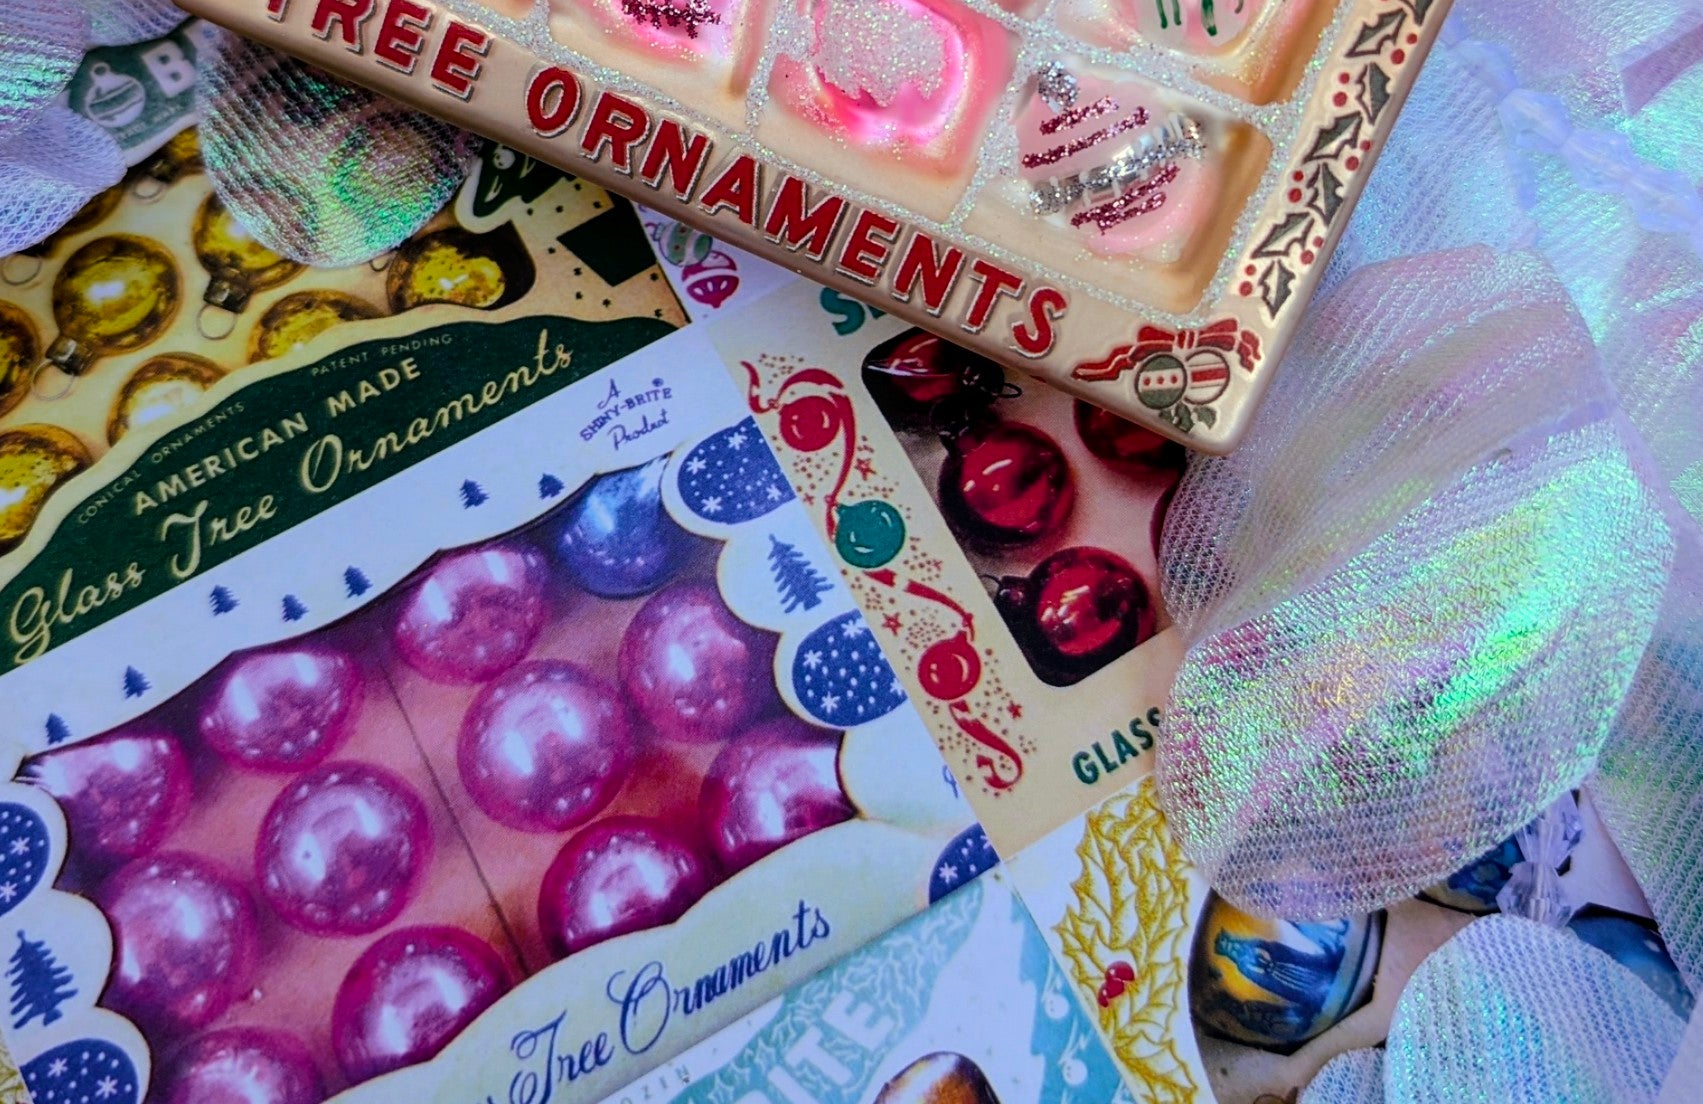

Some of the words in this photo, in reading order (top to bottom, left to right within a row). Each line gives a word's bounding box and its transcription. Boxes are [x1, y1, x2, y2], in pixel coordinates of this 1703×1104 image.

[525, 65, 1070, 360] ORNAMENTS
[134, 411, 309, 516] AMERICAN
[327, 357, 423, 417] MADE
[311, 351, 369, 377] PATENT
[380, 333, 454, 357] PENDING
[8, 561, 146, 665] Glass
[160, 495, 278, 579] Tree
[299, 328, 573, 494] Ornaments
[77, 469, 142, 526] CONICAL
[151, 401, 246, 464] ORNAMENTS
[510, 1008, 615, 1104] Tree
[607, 899, 831, 1054] Ornaments
